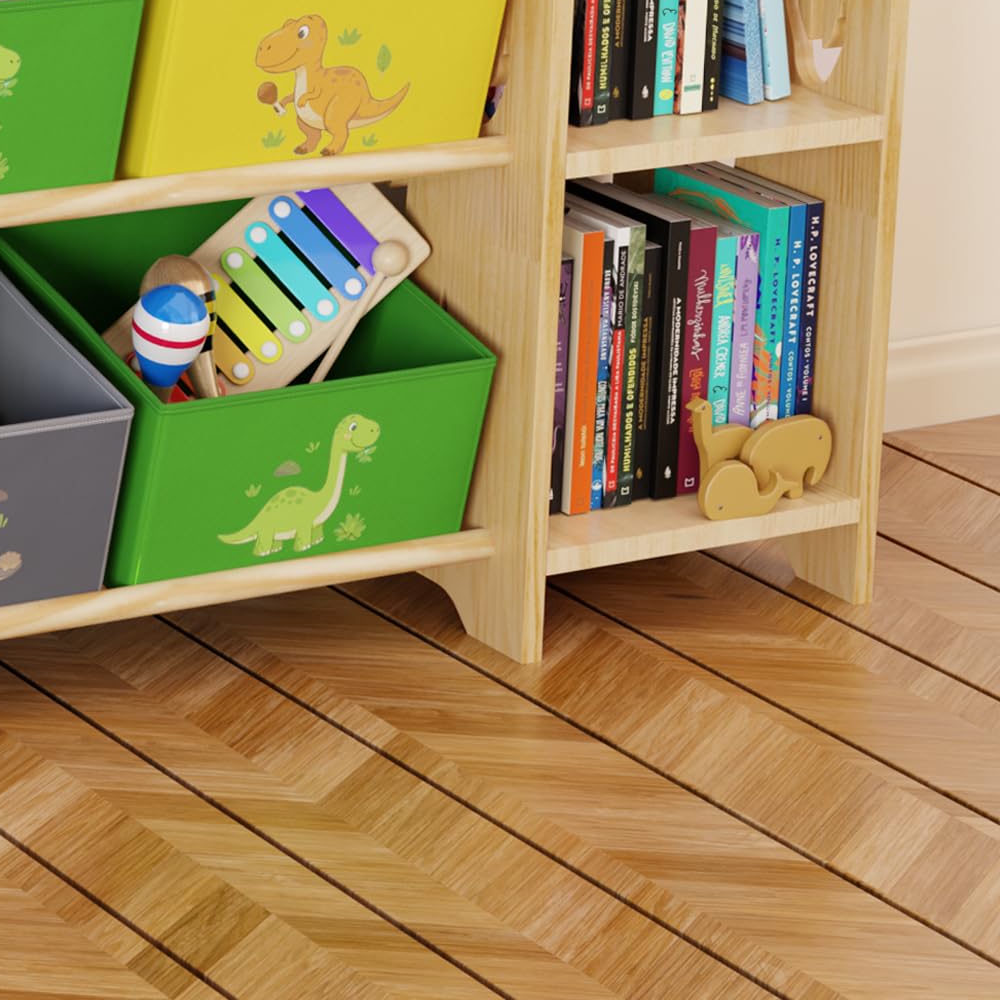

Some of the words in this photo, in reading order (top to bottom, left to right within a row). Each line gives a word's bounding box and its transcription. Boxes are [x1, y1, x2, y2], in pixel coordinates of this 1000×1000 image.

[602, 17, 610, 25] E
[599, 26, 610, 90] HUMILHADOS
[769, 272, 778, 343] LOVECRAFT
[787, 273, 801, 343] LOVECRAFT
[805, 245, 819, 317] LOVECRAFT
[672, 305, 681, 376] MODERNIDADE
[786, 350, 795, 382] CONTOS
[804, 326, 813, 358] CONTOS
[626, 347, 638, 401] OFENDIDOS
[669, 377, 678, 424] IMPRESSA
[802, 363, 810, 396] VOLUME
[623, 412, 633, 472] HUMILHADOS
